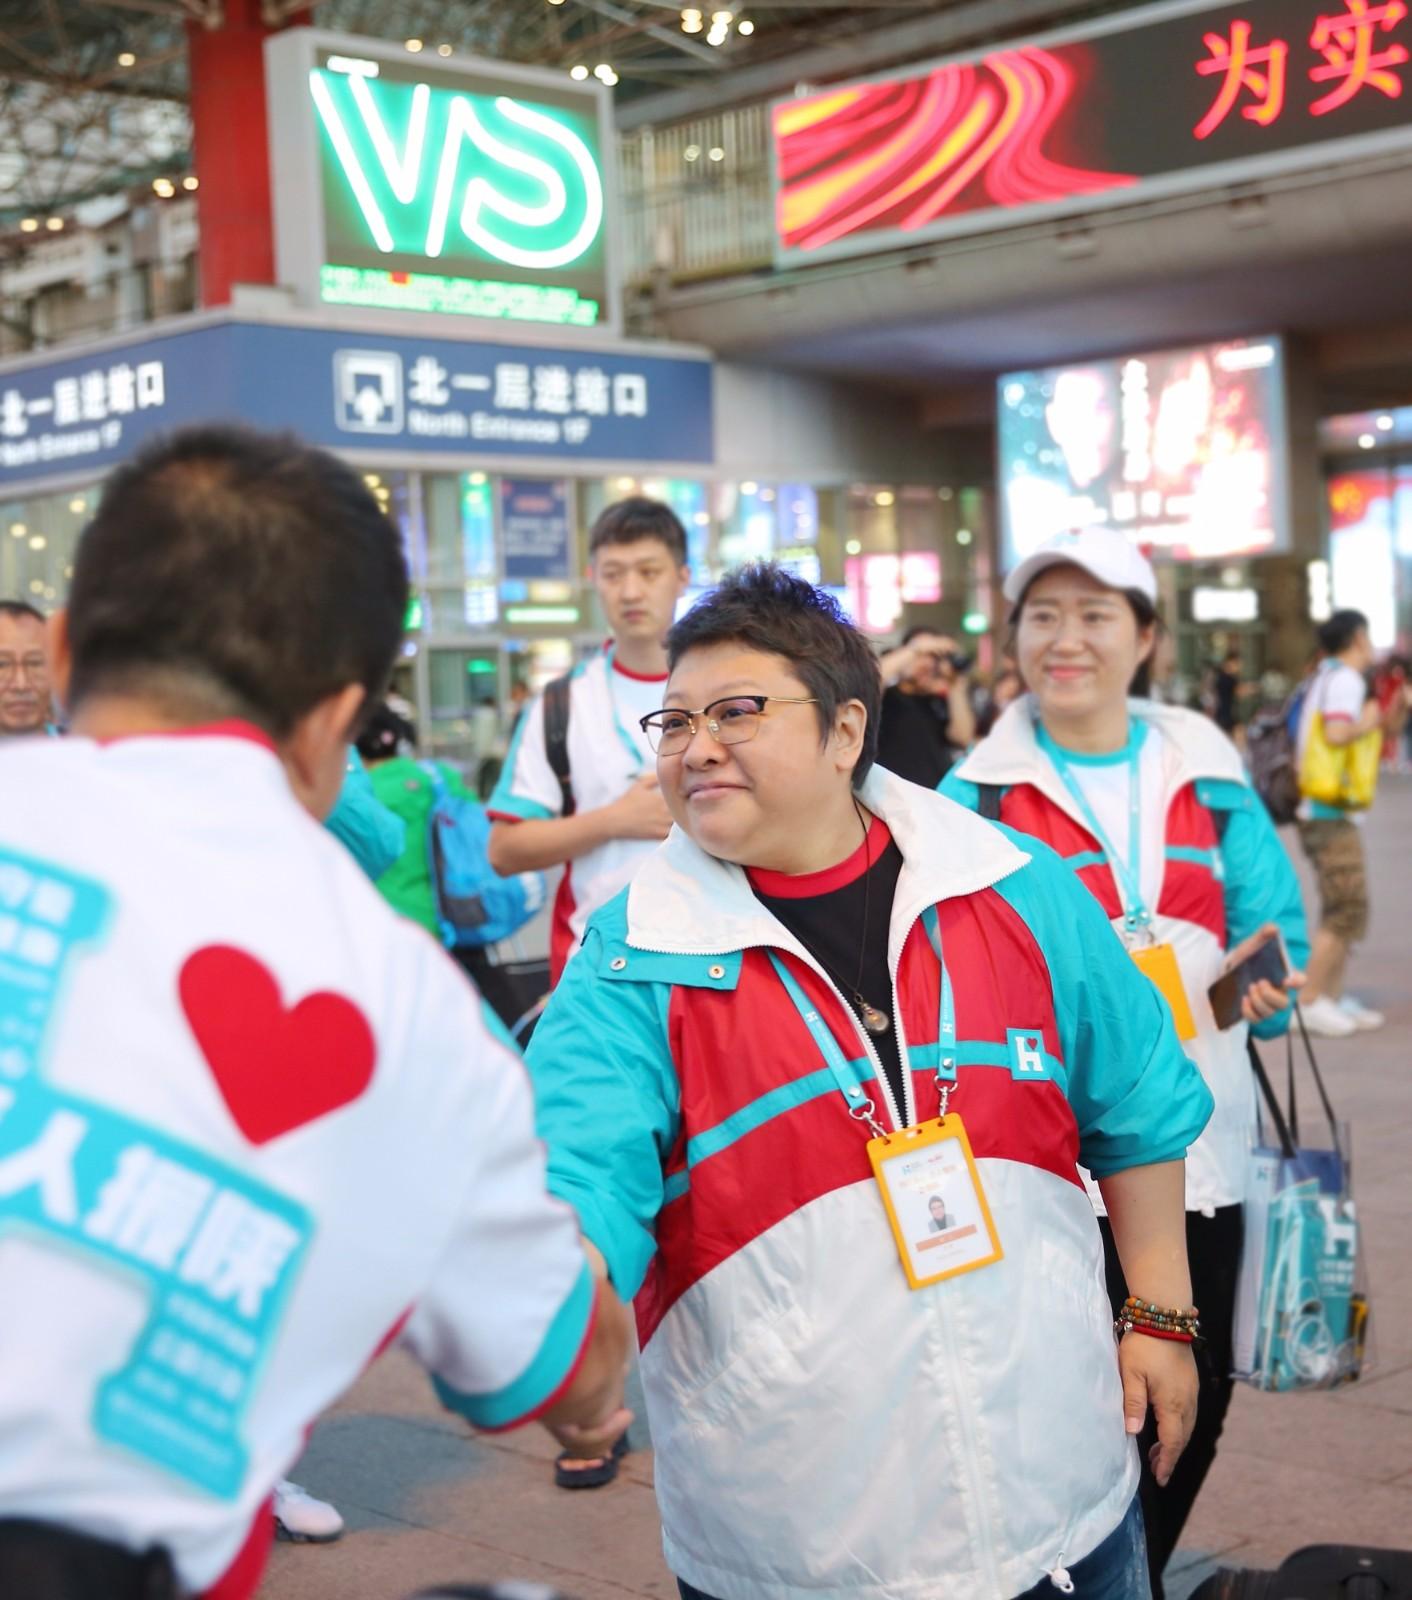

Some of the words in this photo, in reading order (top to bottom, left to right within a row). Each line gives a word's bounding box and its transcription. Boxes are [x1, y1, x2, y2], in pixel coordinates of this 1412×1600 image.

[1193, 0, 1408, 140] 为实
[407, 408, 468, 437] North
[470, 411, 560, 443] Entrance
